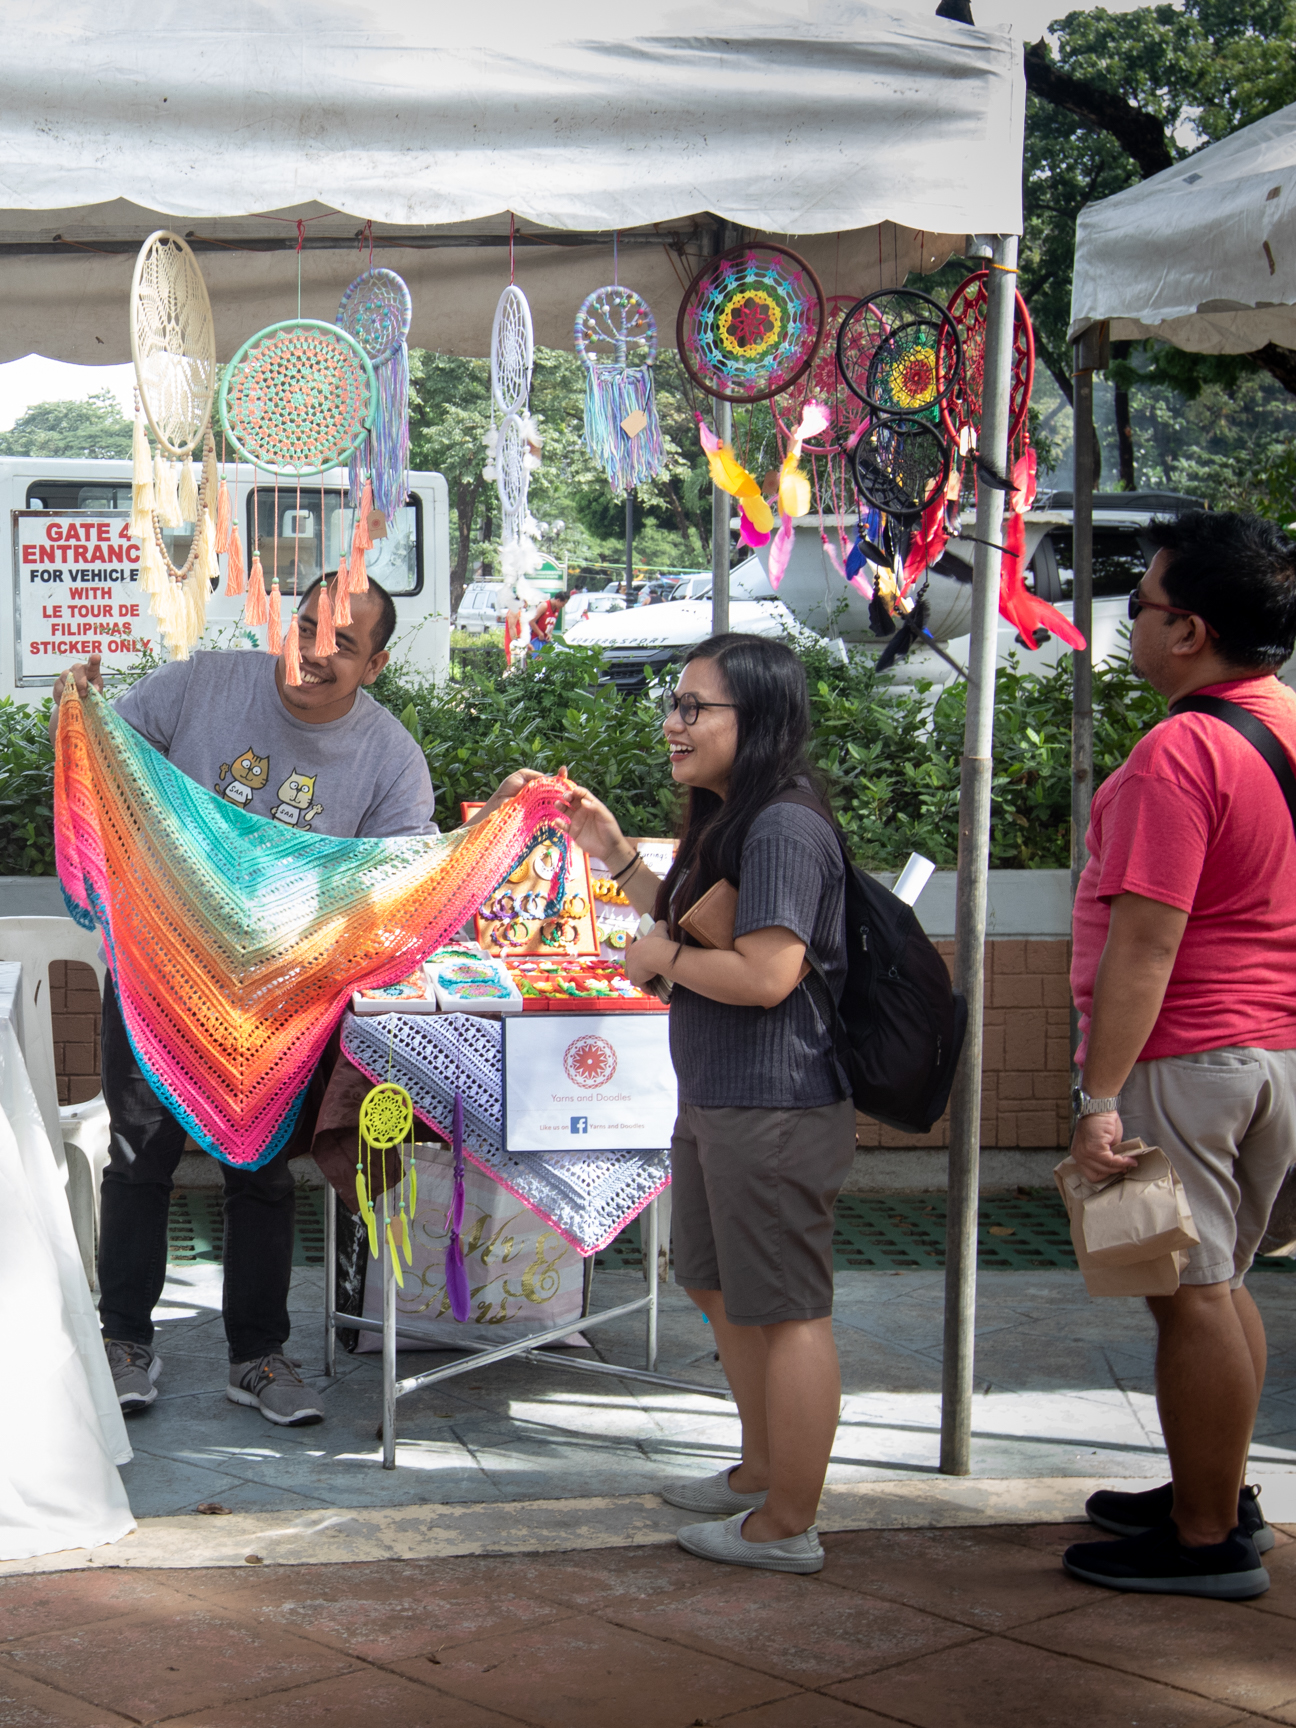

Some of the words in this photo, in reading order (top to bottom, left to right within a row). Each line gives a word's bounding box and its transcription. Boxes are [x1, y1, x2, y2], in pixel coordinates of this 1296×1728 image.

[45, 522, 111, 542] GATE
[118, 522, 132, 542] 4
[22, 543, 141, 564] ENTRANC
[30, 568, 64, 583] FOR
[68, 568, 140, 583] VEHICLE
[69, 586, 112, 600] WITH
[42, 605, 63, 619] LE
[67, 604, 114, 619] TOUR
[118, 604, 140, 617] DE
[51, 621, 132, 636] FILIPINAS
[29, 640, 103, 655] STICKER
[622, 637, 670, 645] SPORT
[229, 785, 244, 797] SAA
[279, 808, 294, 819] SAA
[551, 1093, 574, 1102] Yarns
[576, 1093, 594, 1102] and
[596, 1092, 632, 1102] Doodles
